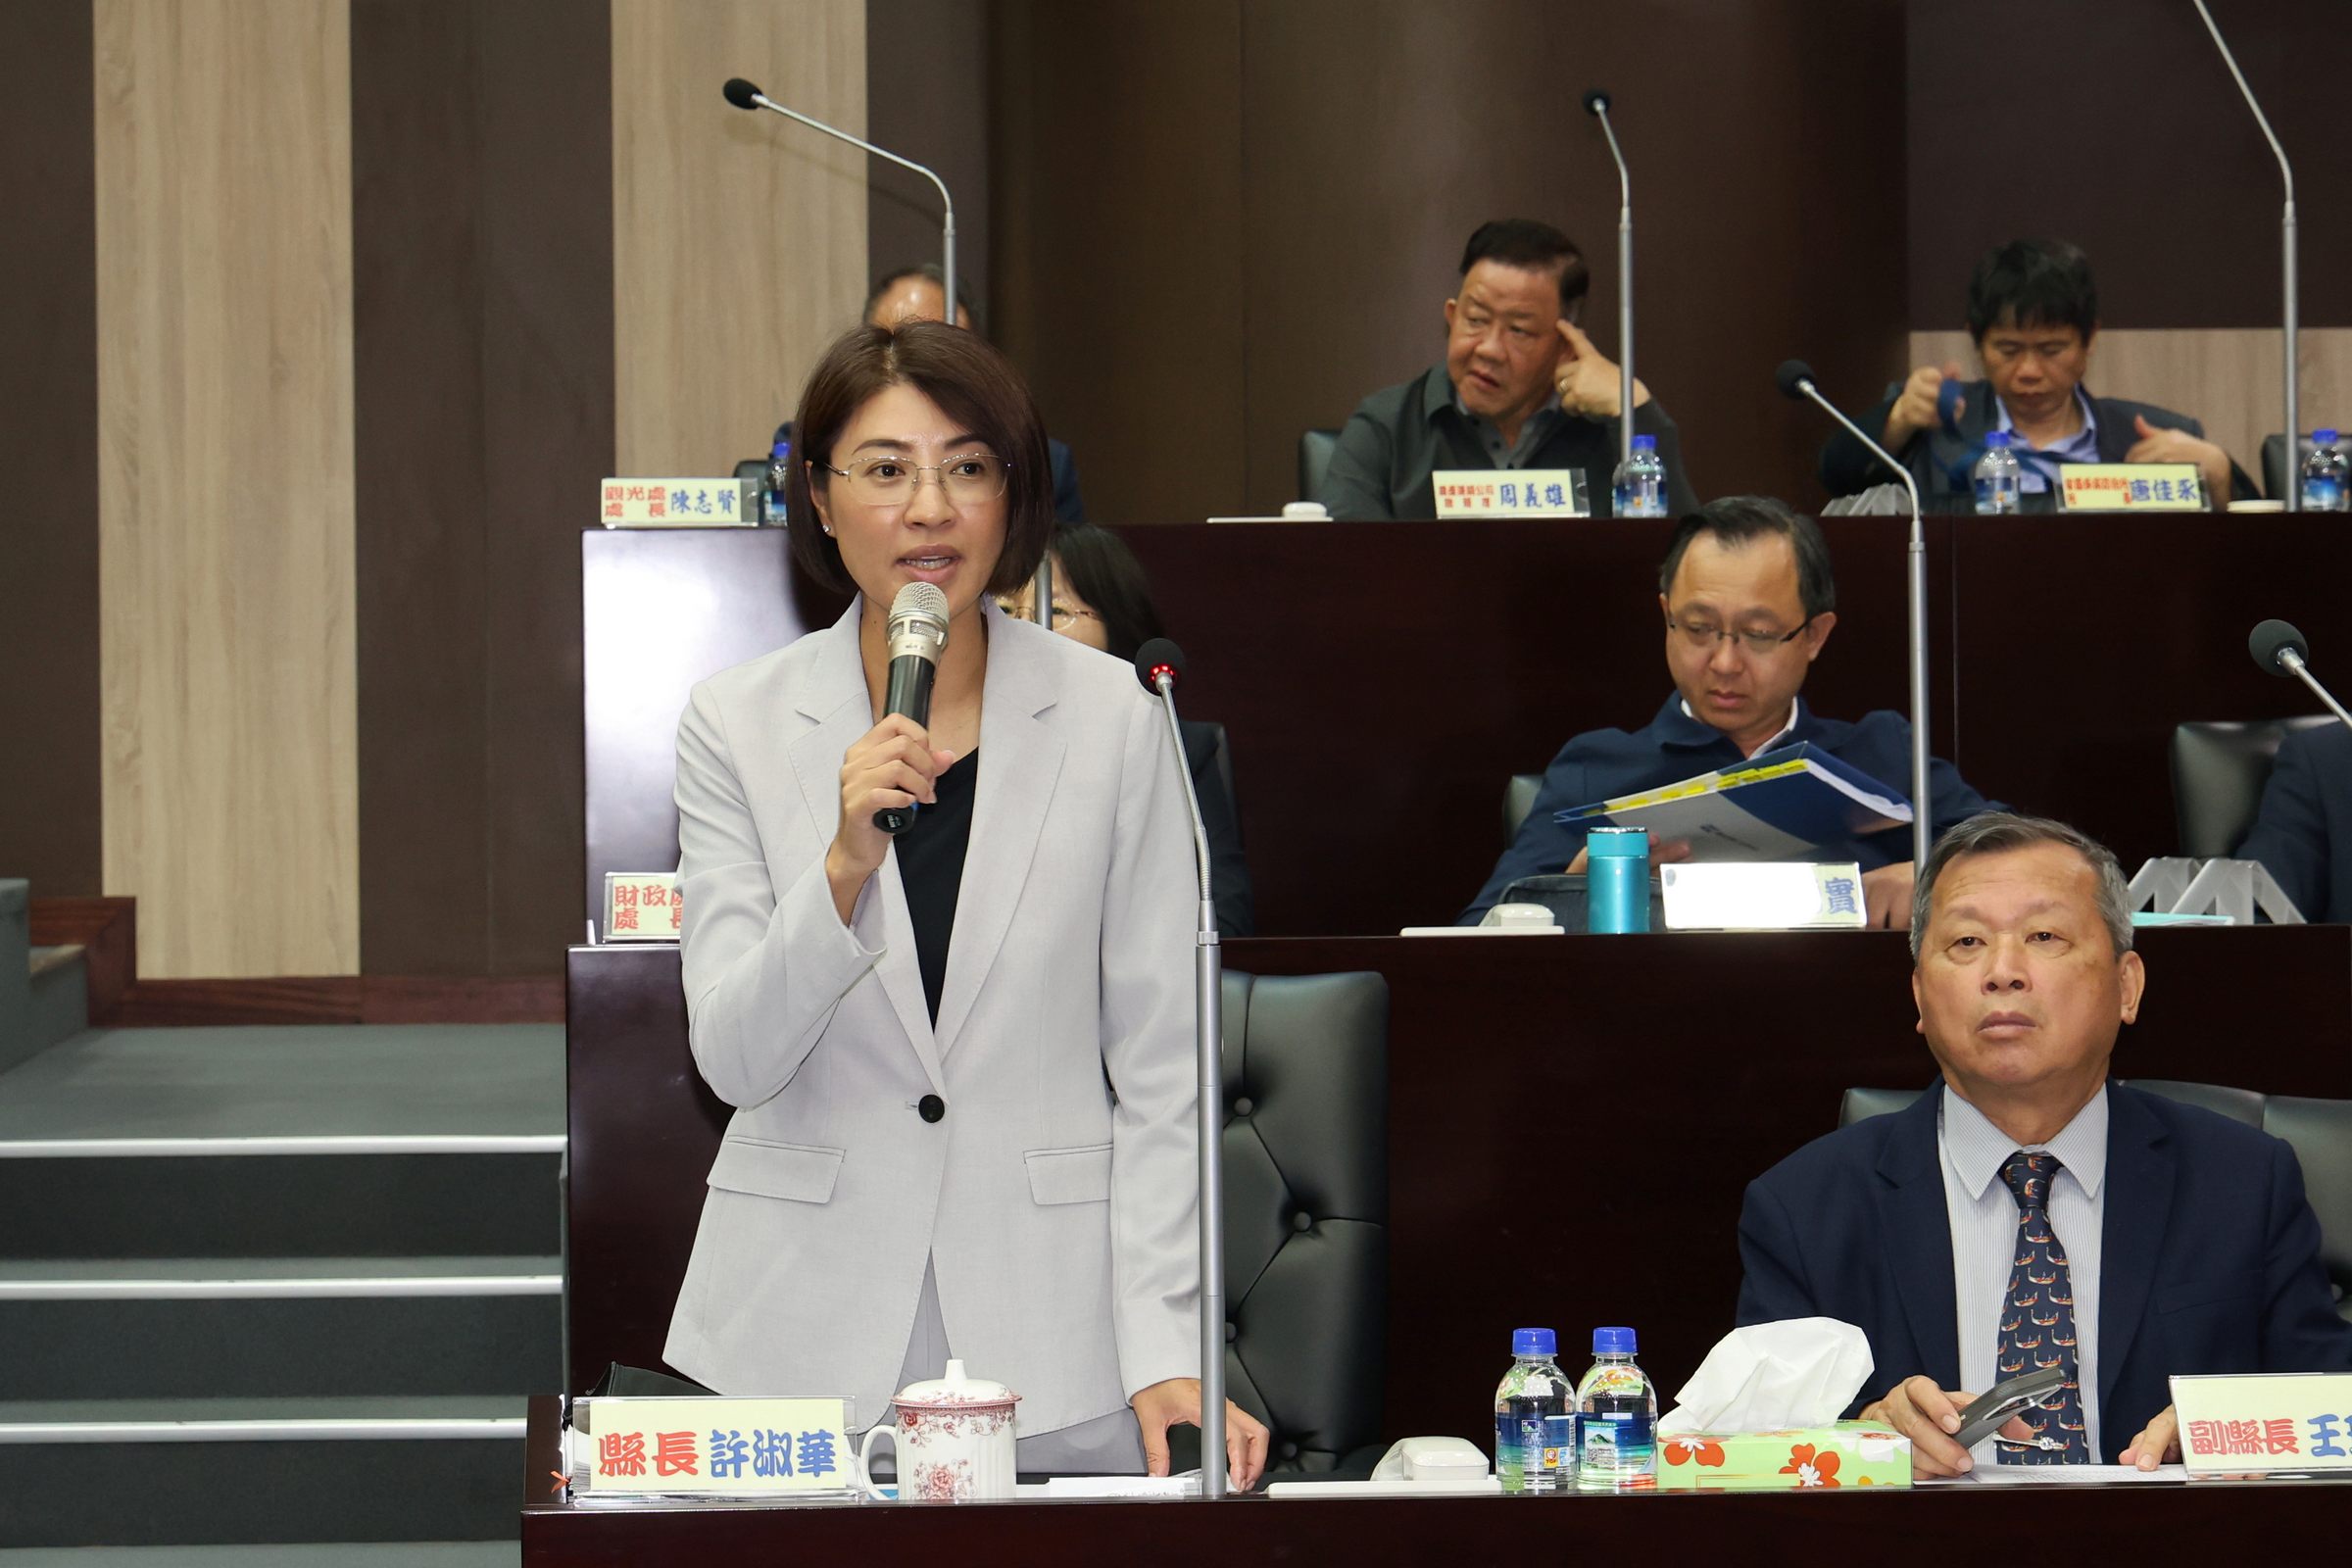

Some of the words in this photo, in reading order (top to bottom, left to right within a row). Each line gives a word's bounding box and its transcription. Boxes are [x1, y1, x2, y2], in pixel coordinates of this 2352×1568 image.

[671, 489, 736, 514] 陳志賢
[1499, 482, 1566, 509] 周義雄
[2187, 1418, 2300, 1455] 副縣長
[2307, 1413, 2352, 1457] 王
[598, 1431, 700, 1477] 縣長
[709, 1429, 837, 1478] 許淑華
